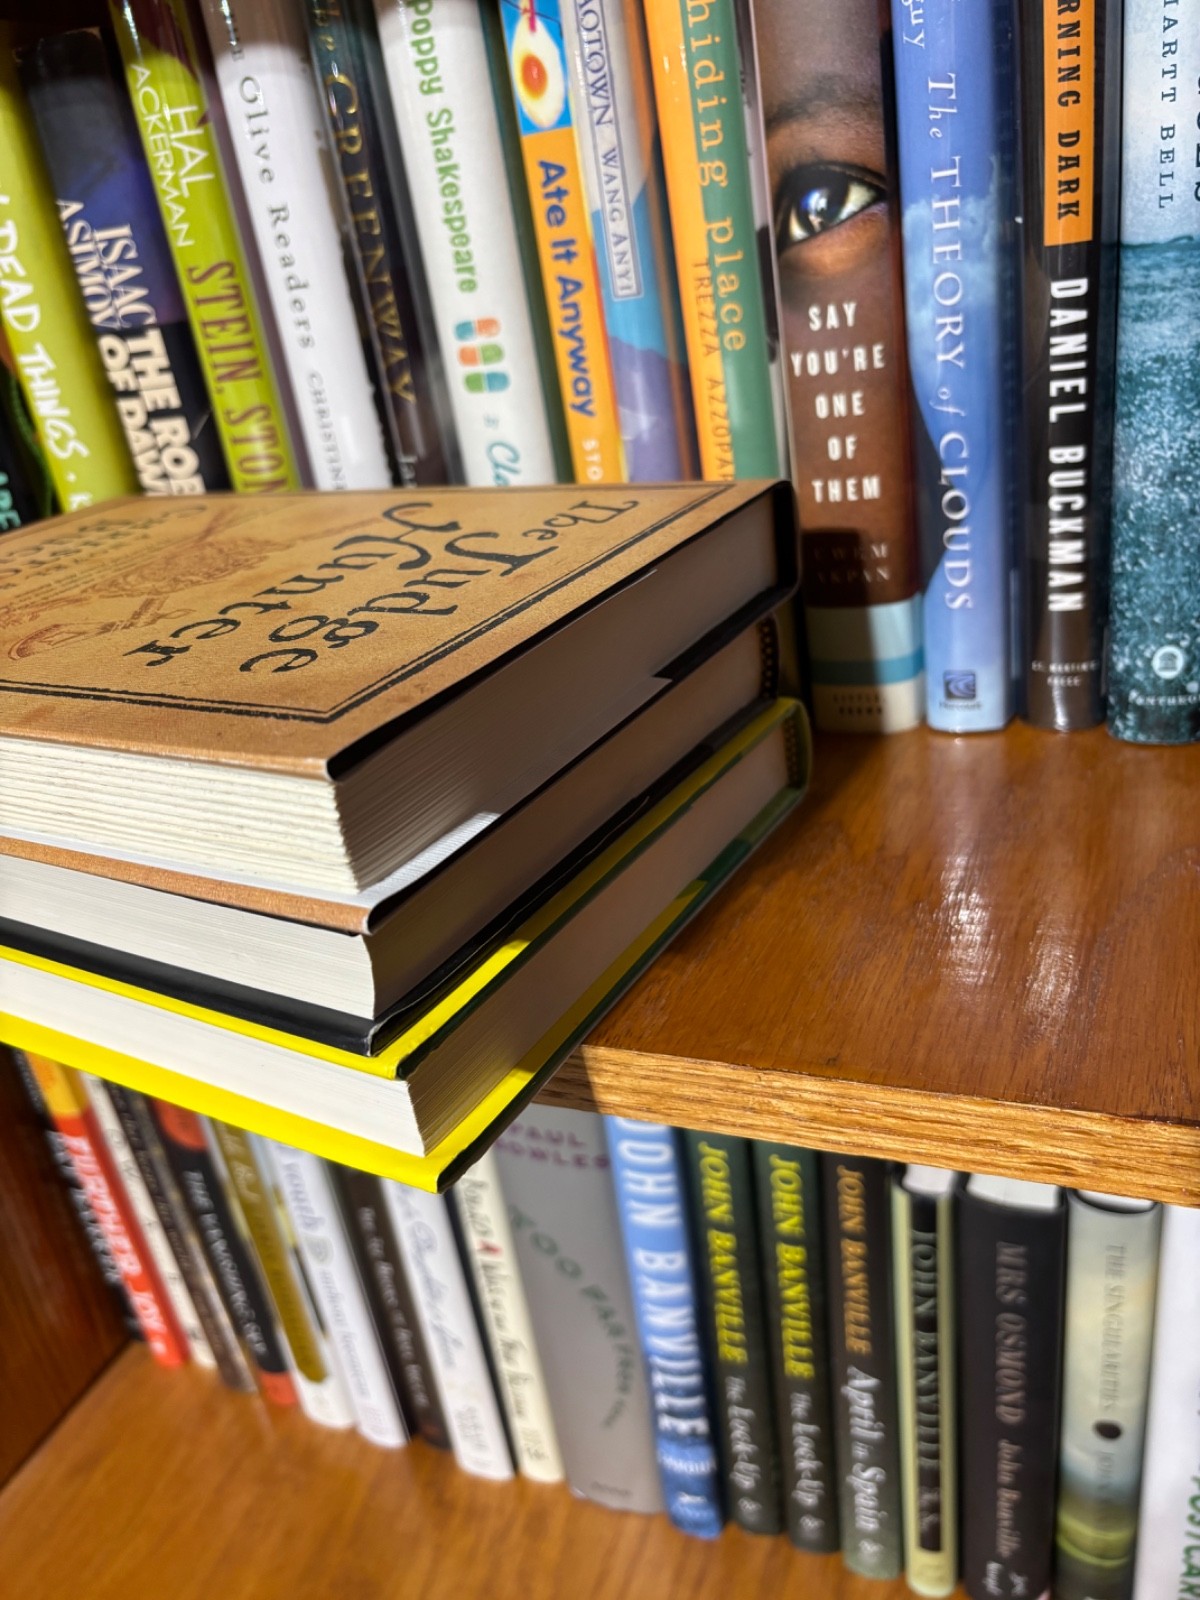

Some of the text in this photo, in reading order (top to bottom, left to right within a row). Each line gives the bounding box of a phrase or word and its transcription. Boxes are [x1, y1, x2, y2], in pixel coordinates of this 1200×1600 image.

[169, 104, 215, 198] HAL
[406, 0, 478, 294] poppy Shakespeare
[1158, 0, 1179, 209] ARTT BELL
[130, 63, 195, 248] ACKERMAN
[601, 146, 626, 223] WANG
[686, 0, 748, 353] hiding place
[1057, 130, 1081, 221] DARK
[239, 75, 276, 185] Olive
[268, 203, 315, 350] Readers
[612, 232, 635, 292] ANYI
[56, 199, 122, 330] ASIMOV
[93, 223, 158, 329] ISAAC
[538, 159, 595, 419] Ate It Anyway
[691, 259, 722, 358] TREZZA
[97, 334, 141, 391] OF
[790, 343, 887, 378] YOU'RE
[808, 302, 859, 332] SAY
[928, 72, 974, 611] The THEORY of CLOUDS
[19, 342, 90, 460] THINGS
[125, 328, 183, 412] THE
[815, 390, 865, 420] ONE
[811, 475, 881, 504] THEM
[827, 435, 858, 461] OF
[1048, 277, 1088, 612] DANIEL BUCKMAN
[521, 500, 640, 542] The
[122, 502, 460, 667] Hunter
[240, 531, 560, 674] Judge
[698, 1140, 735, 1225] JOHN
[768, 1152, 805, 1237] JOHN
[836, 1164, 867, 1236] JOHN
[707, 1228, 749, 1366] BANVILLE
[775, 1241, 816, 1381] BANVILLE
[840, 1237, 873, 1357] BANVILLE
[911, 1230, 939, 1315] JOHN
[995, 1241, 1028, 1304] MRS
[633, 1248, 711, 1436] BANVILLE
[995, 1312, 1029, 1426] OSMOND
[841, 1365, 885, 1443] April
[912, 1329, 941, 1470] BANVILLE
[846, 1462, 887, 1532] Spain
